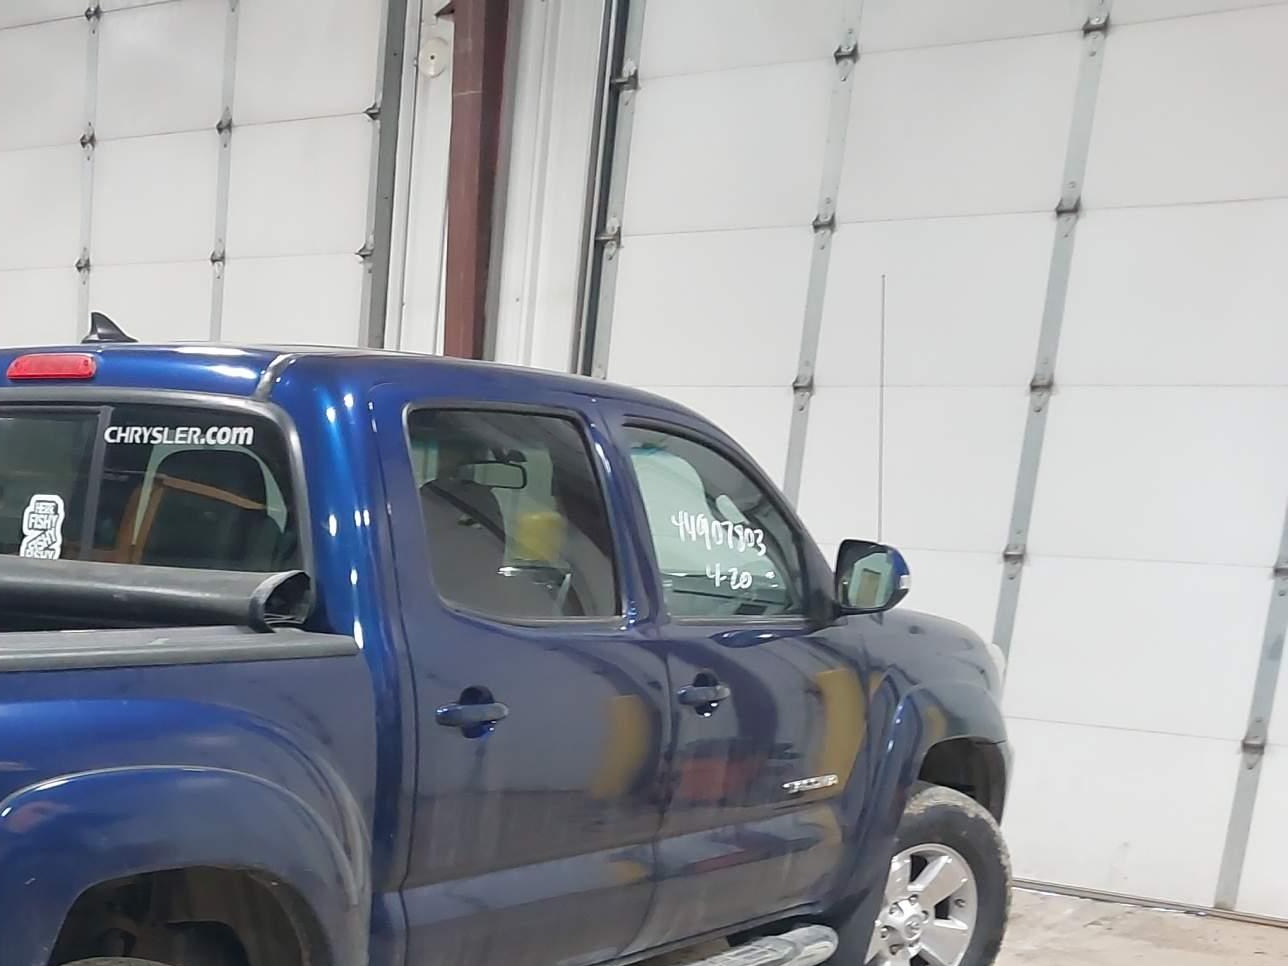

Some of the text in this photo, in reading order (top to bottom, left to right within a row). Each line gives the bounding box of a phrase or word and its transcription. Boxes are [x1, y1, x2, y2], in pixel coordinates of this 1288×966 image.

[104, 426, 254, 445] CHRYSLER.com
[29, 513, 59, 530] FISHY
[671, 510, 767, 556] 44907803
[706, 563, 753, 590] 4-20
